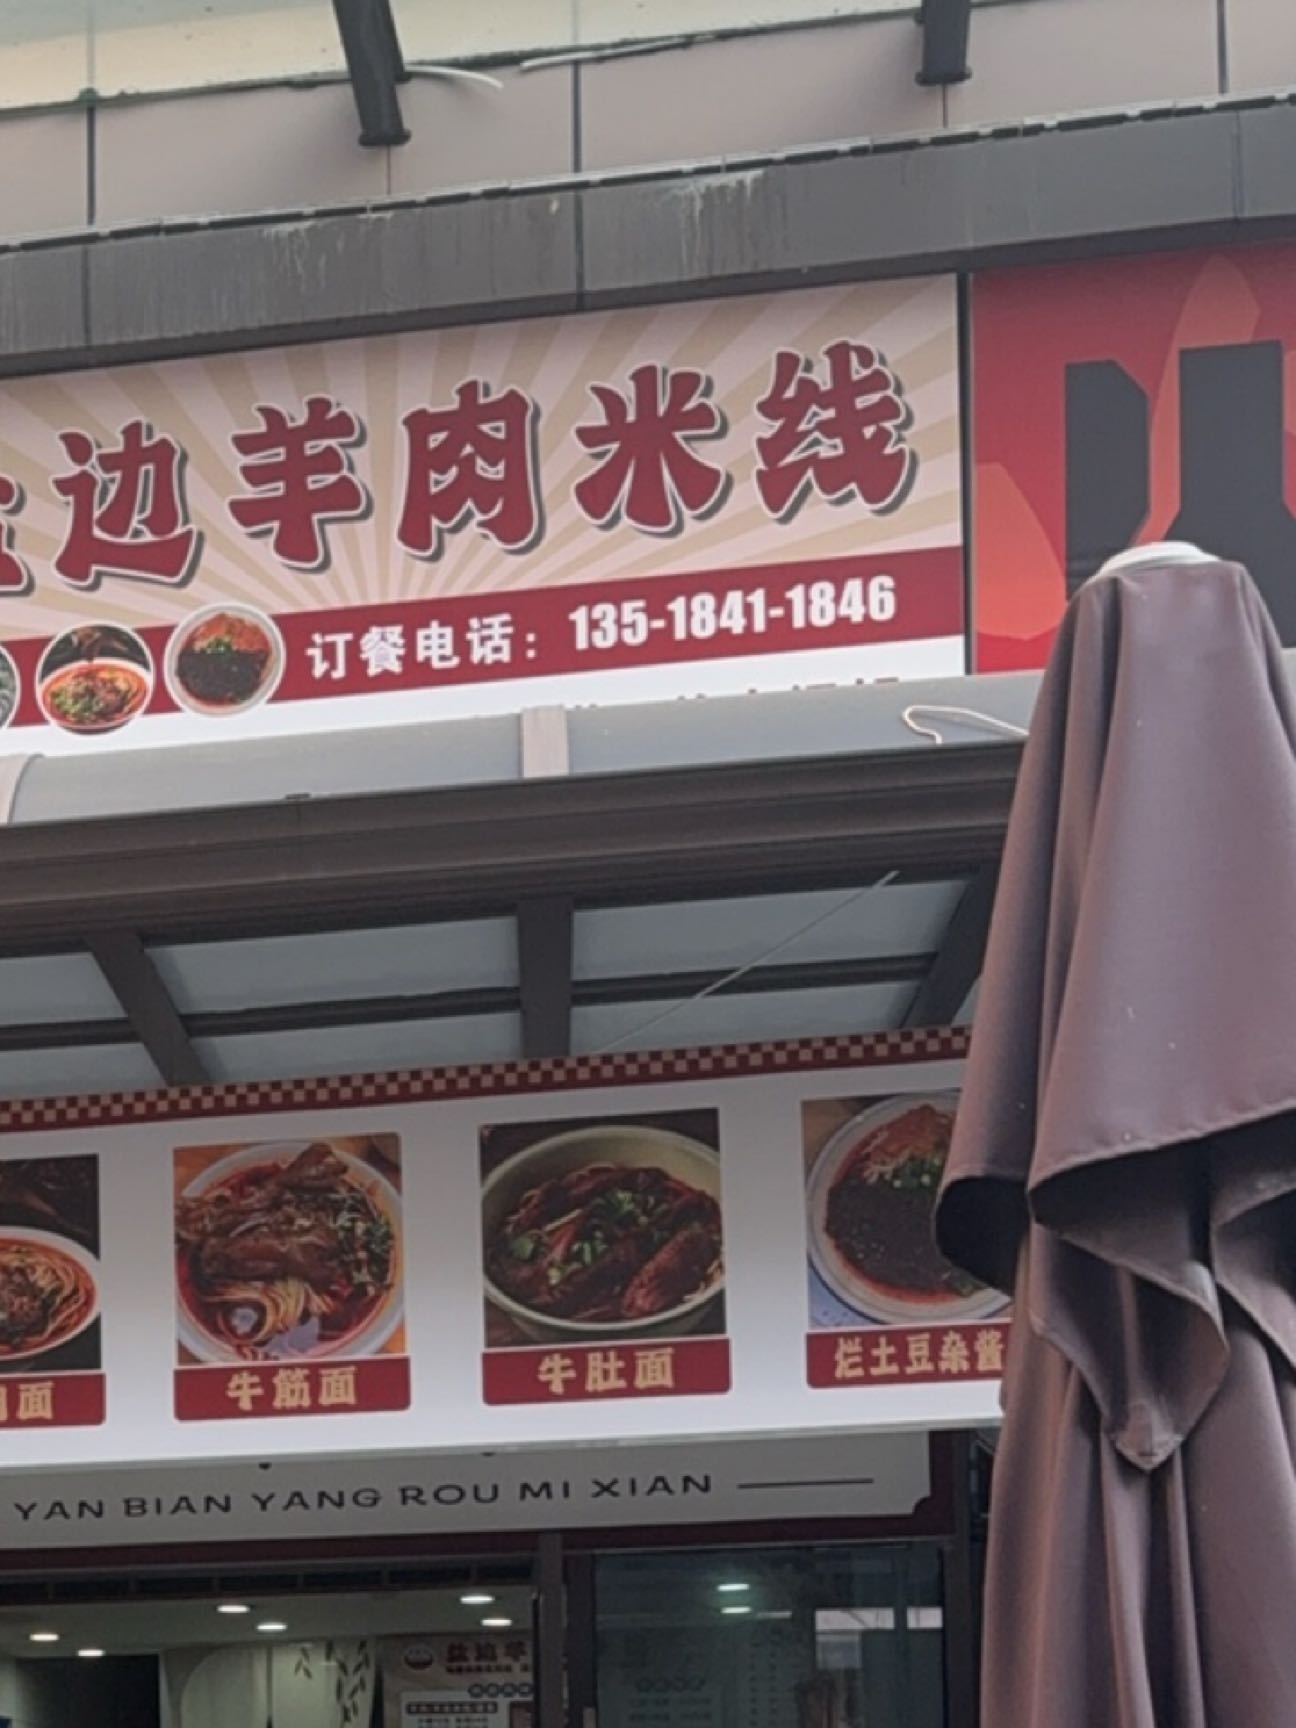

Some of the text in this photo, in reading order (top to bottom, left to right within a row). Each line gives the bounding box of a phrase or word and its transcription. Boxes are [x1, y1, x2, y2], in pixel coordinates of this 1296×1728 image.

[569, 575, 896, 650] 135-1841-1846
[227, 1366, 357, 1411] 牛筋面
[538, 1347, 674, 1394] 牛肚面
[17, 1474, 713, 1522] YAN BIAN YANG ROU MI XIAN
